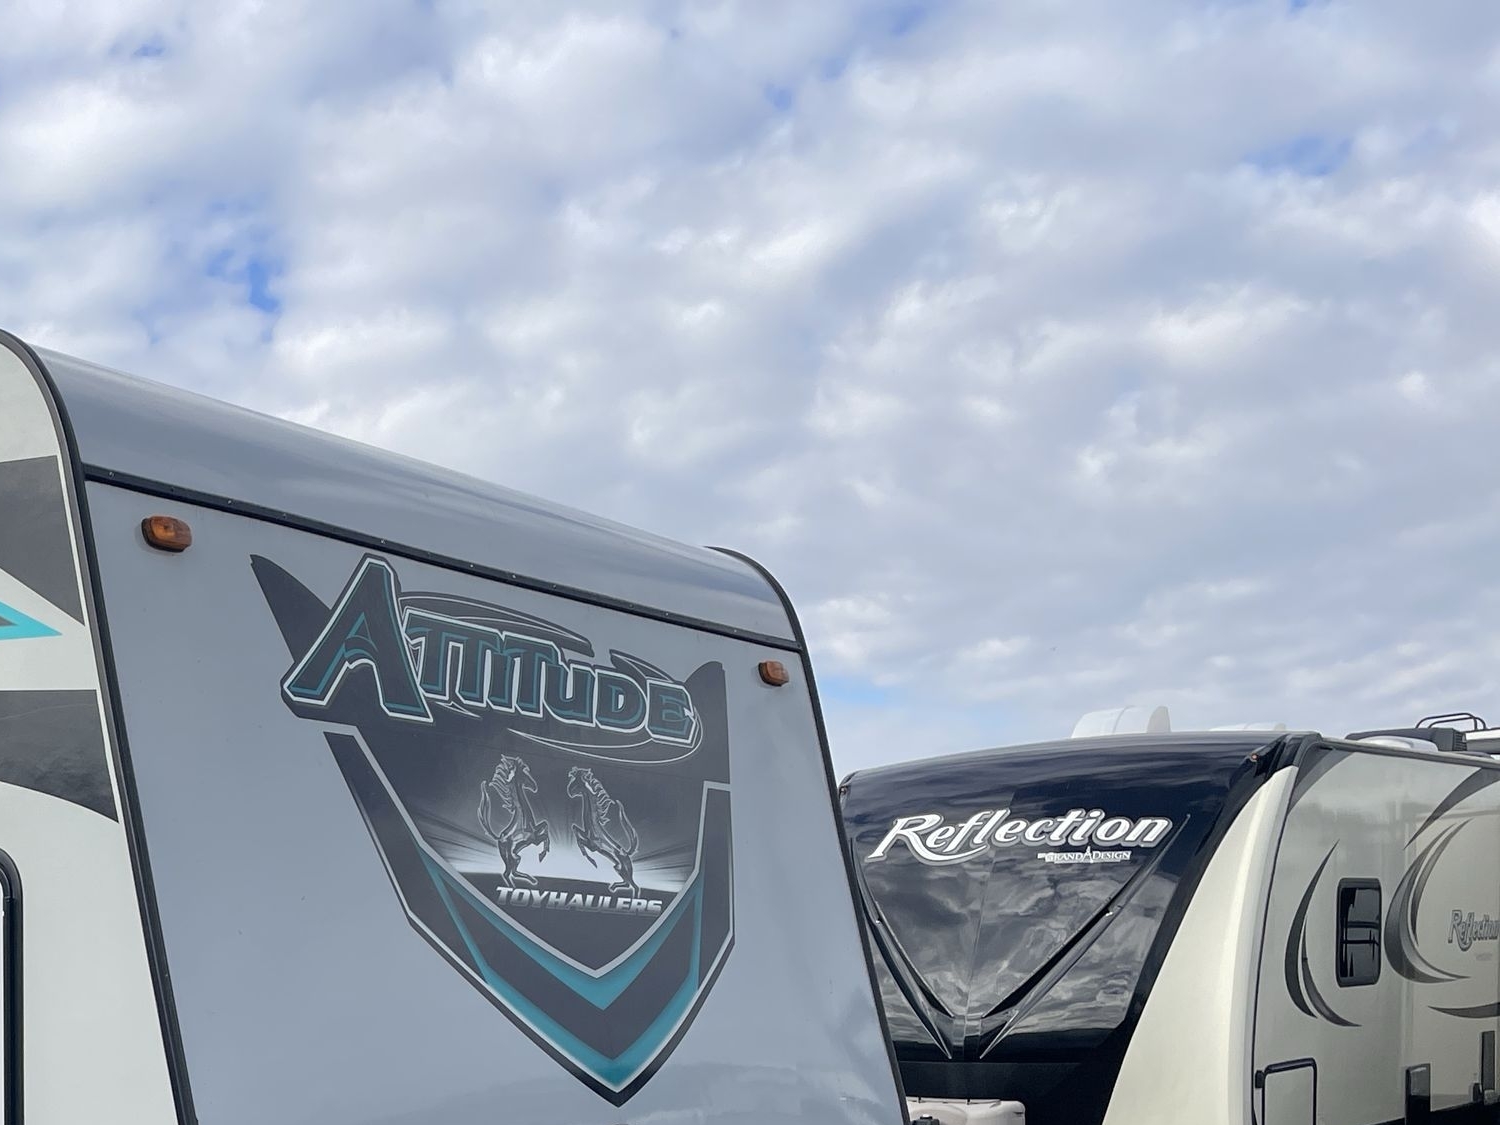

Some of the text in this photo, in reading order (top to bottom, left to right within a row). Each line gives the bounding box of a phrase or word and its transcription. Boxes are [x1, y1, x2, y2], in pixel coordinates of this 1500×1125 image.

[283, 556, 698, 744] ATTITUDE
[867, 806, 1174, 864] Reflection
[1092, 850, 1132, 861] DESIGN
[496, 886, 664, 917] TOYHAULERS
